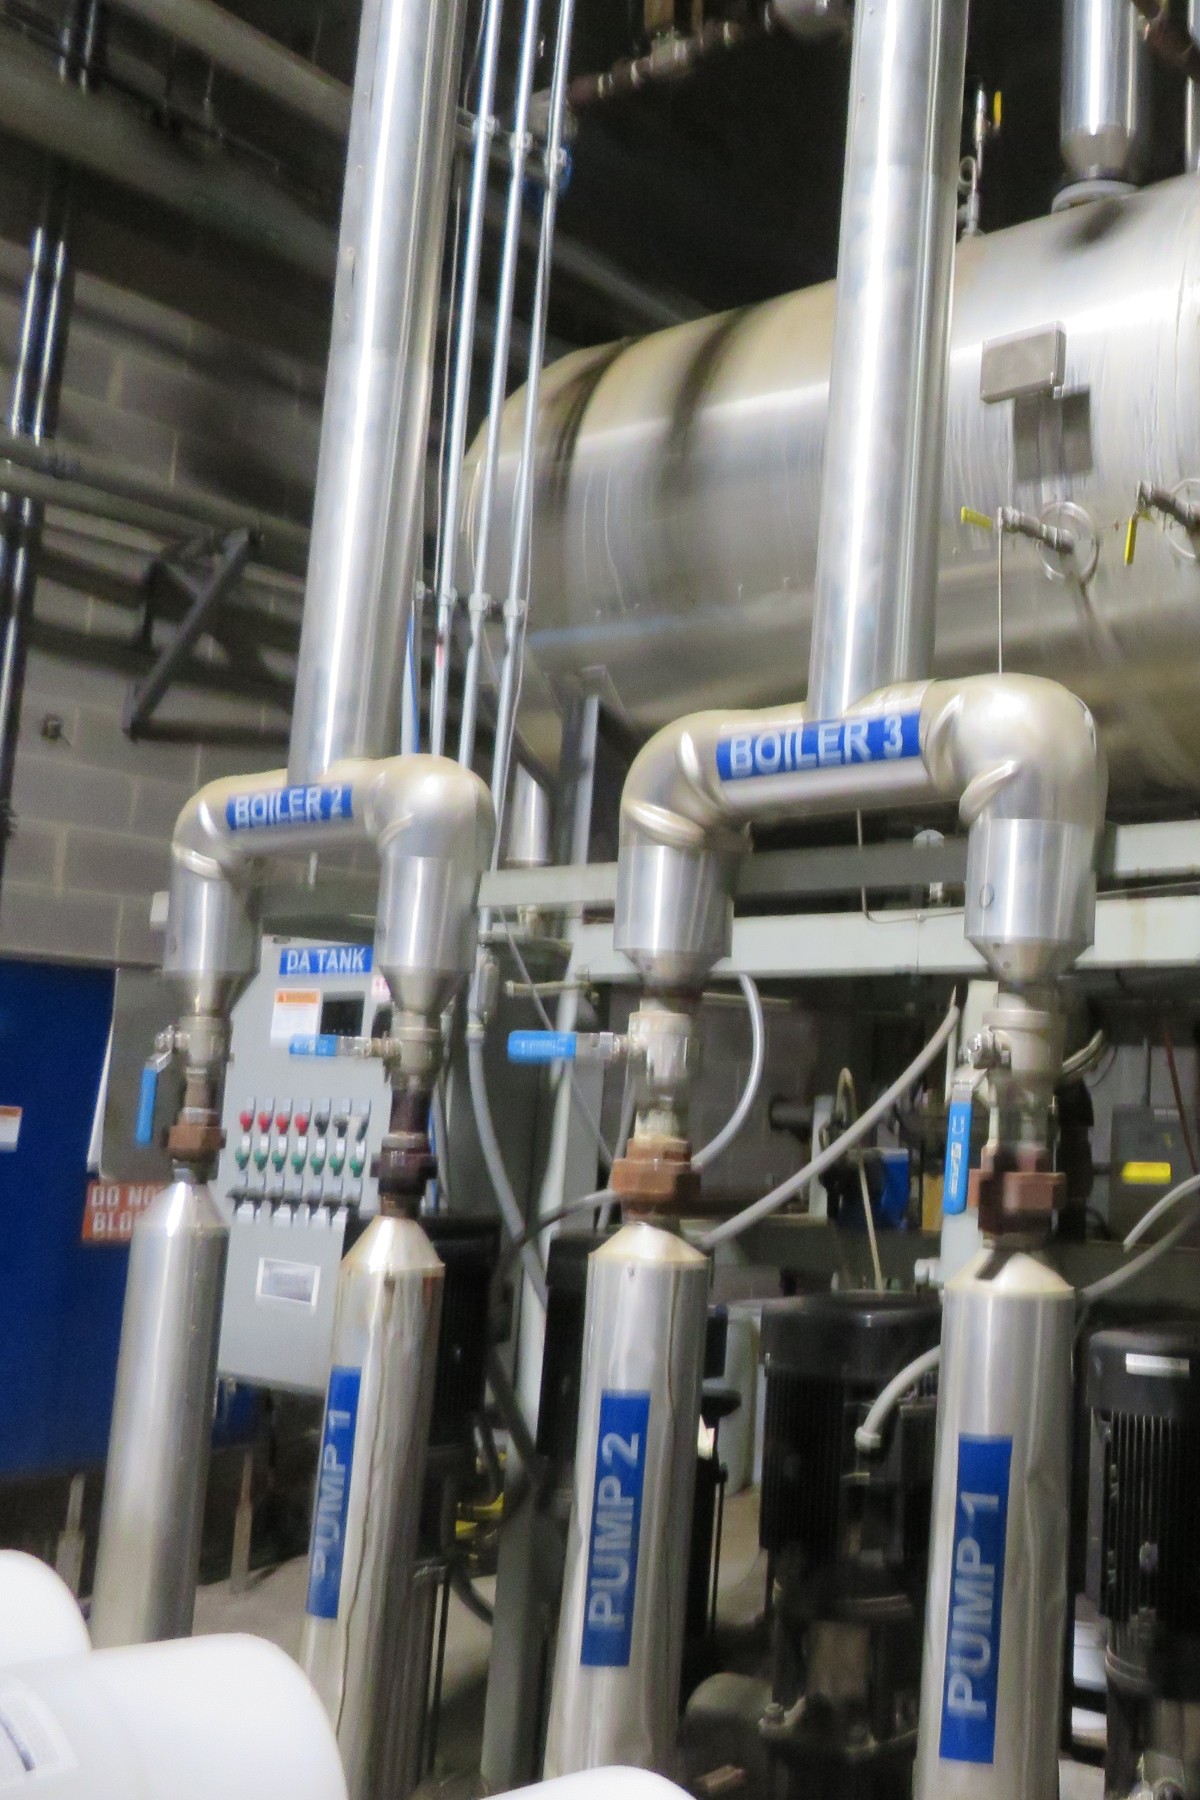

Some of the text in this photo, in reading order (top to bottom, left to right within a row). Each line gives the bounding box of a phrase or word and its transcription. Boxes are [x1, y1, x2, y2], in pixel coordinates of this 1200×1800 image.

[730, 714, 904, 778] BOILER 3
[235, 784, 343, 825] BOILER 2
[287, 947, 365, 971] DA TANK
[92, 1185, 159, 1207] DO NO
[92, 1210, 134, 1233] BLO
[311, 1410, 350, 1584] PUMP 1
[588, 1432, 640, 1631] PUMP 2
[948, 1491, 999, 1720] PUMP 1
